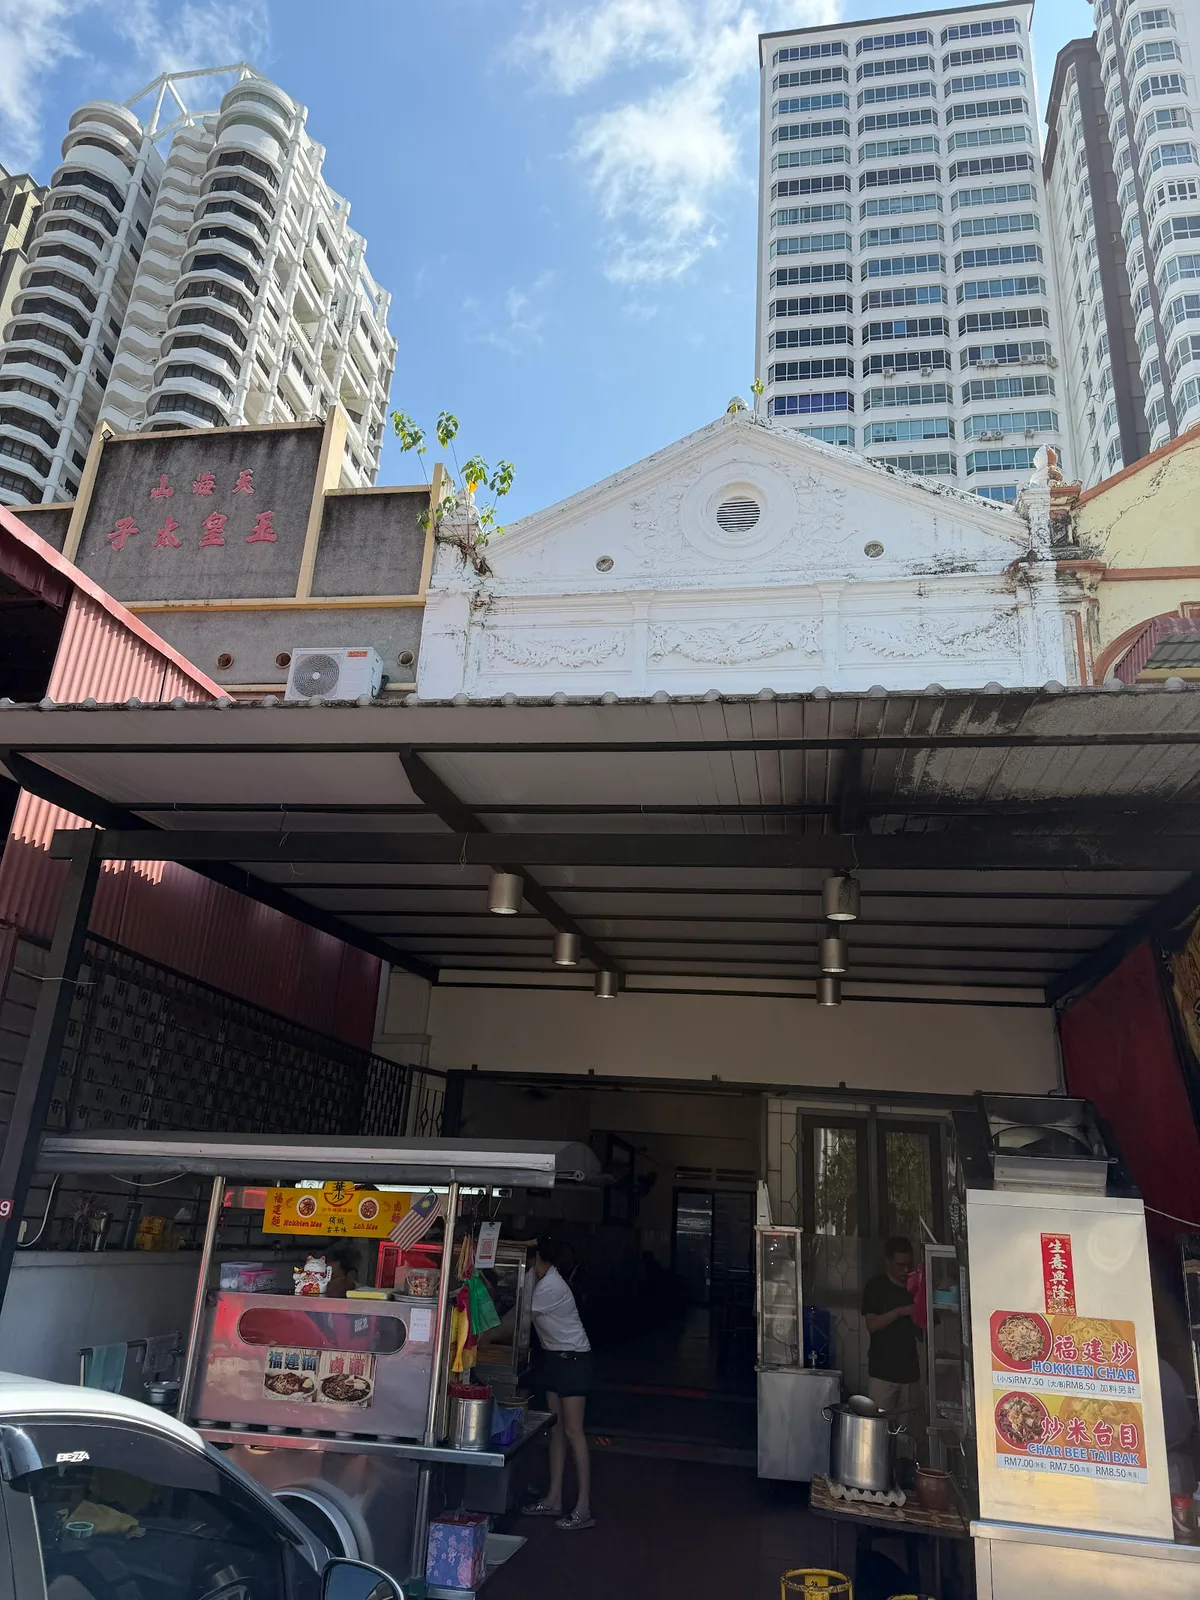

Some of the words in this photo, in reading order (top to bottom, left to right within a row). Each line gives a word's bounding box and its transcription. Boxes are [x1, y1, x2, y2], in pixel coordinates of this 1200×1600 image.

[283, 1219, 310, 1227] Hokkien
[1047, 1238, 1071, 1299] 生意興隆
[1053, 1335, 1135, 1366] 福建炒
[1031, 1360, 1094, 1378] HOKKIEN
[1097, 1366, 1136, 1381] CHAR
[1041, 1416, 1139, 1450] 炒米台目
[56, 1450, 91, 1463] BEZZA
[1028, 1443, 1063, 1457] CHAR
[1065, 1446, 1087, 1460] BEE
[1089, 1449, 1112, 1463] TAI
[1113, 1451, 1140, 1466] BAK
